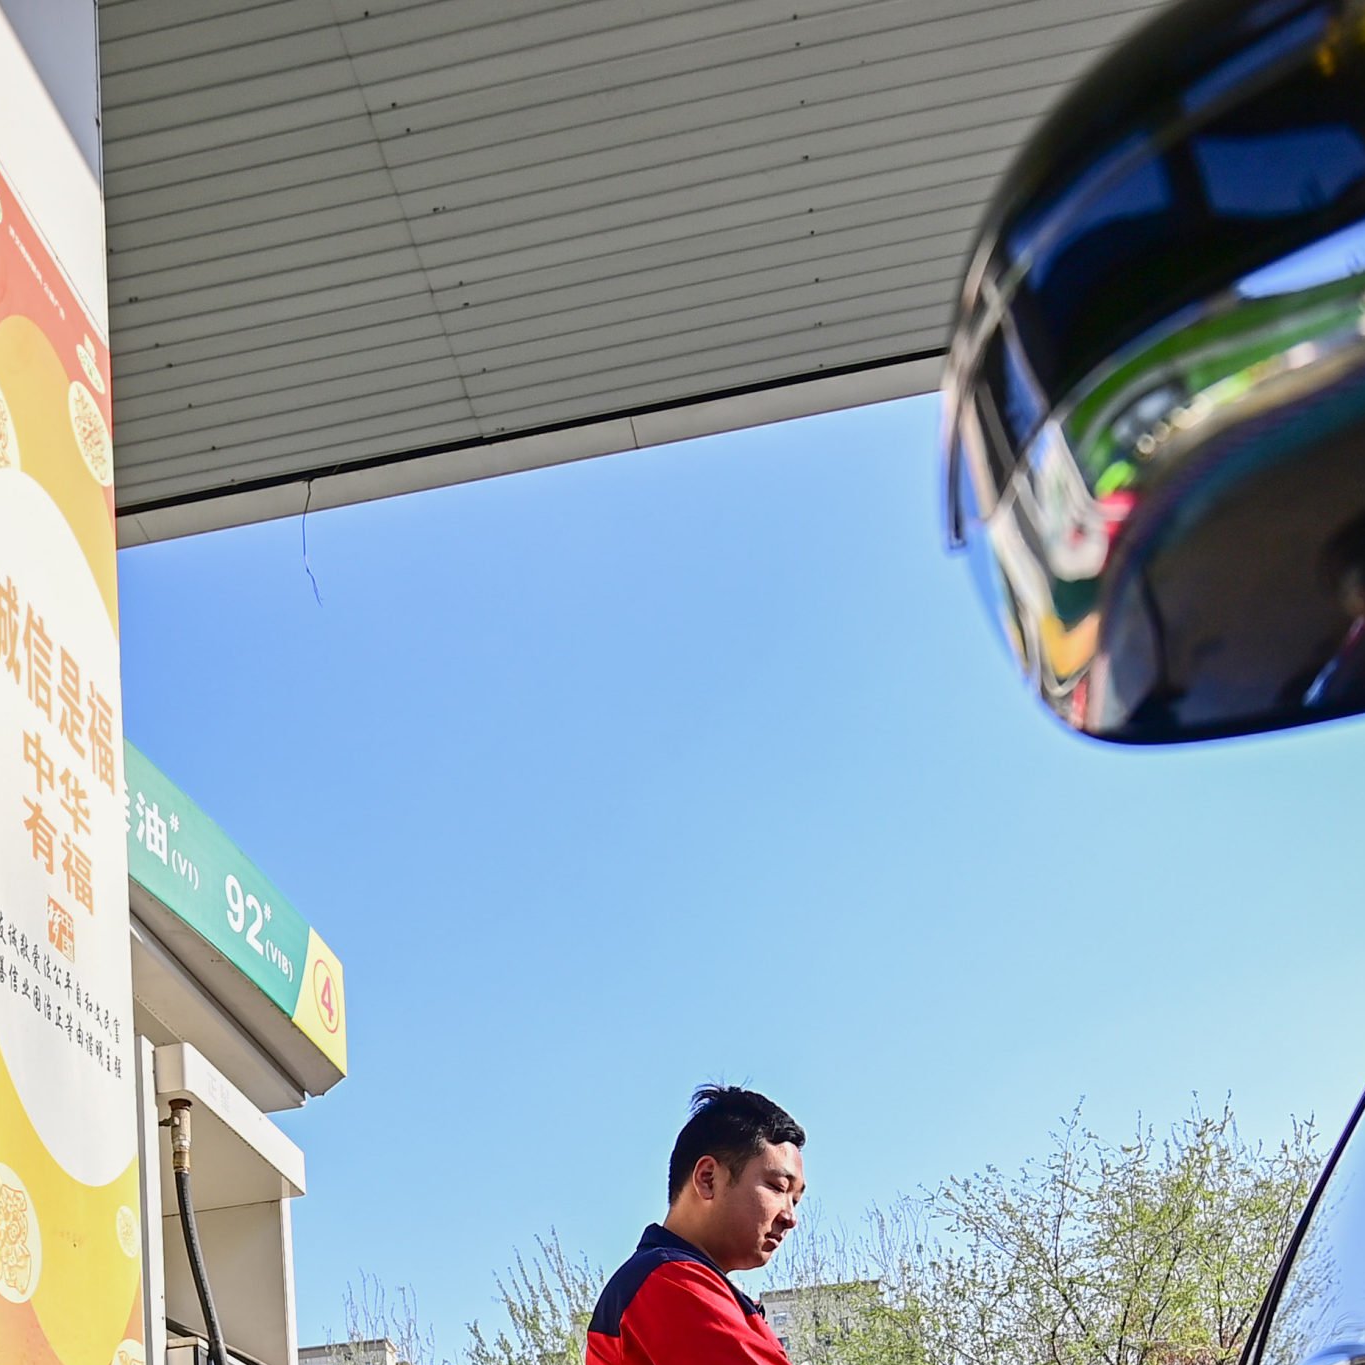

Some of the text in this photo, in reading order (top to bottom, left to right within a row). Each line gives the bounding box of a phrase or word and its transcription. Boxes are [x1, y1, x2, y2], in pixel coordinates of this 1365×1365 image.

[23, 730, 91, 835] 中华
[23, 795, 94, 915] 有福
[171, 849, 199, 890] (VI)
[321, 976, 334, 1023] 4
